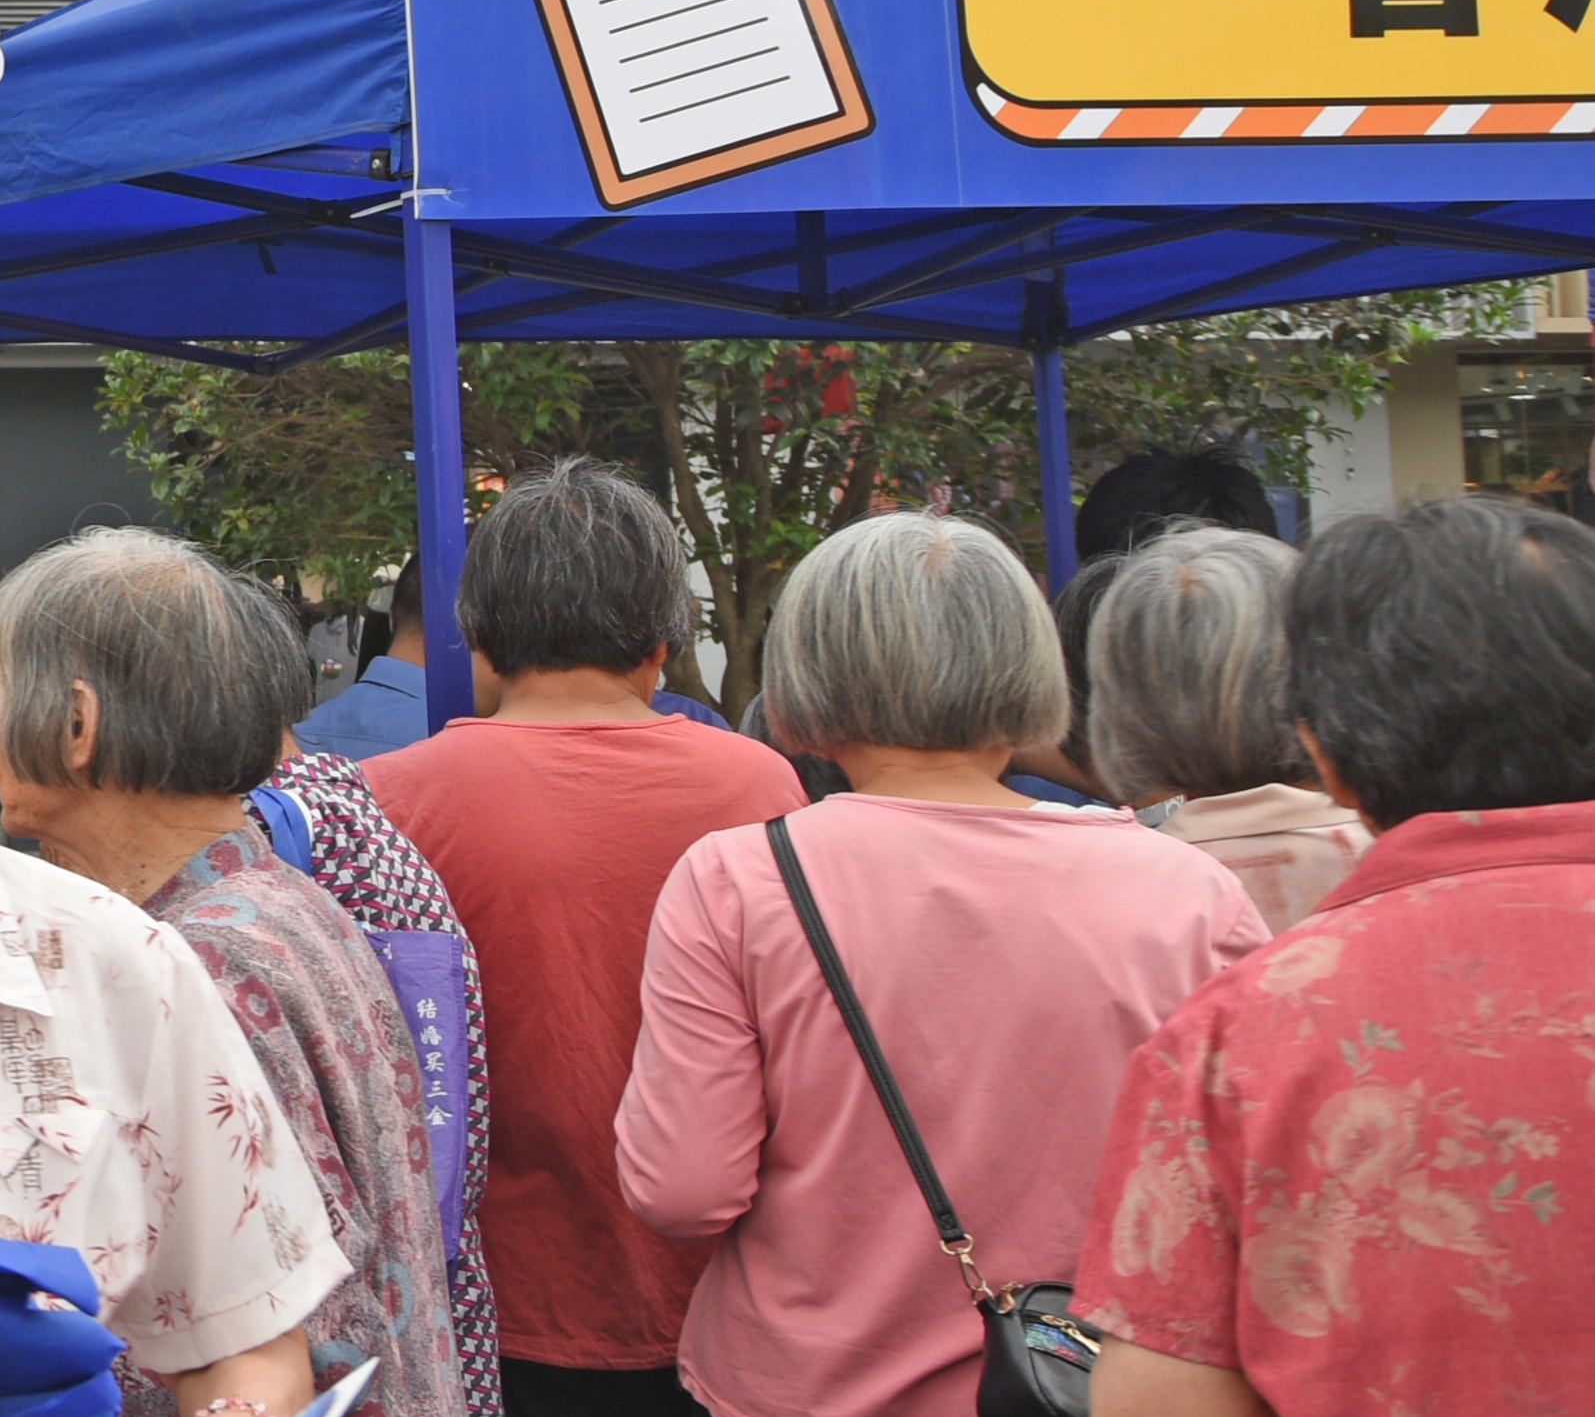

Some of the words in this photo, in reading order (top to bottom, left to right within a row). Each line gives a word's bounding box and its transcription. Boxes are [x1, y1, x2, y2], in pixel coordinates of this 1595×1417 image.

[416, 997, 453, 1127] 结婚买三金
